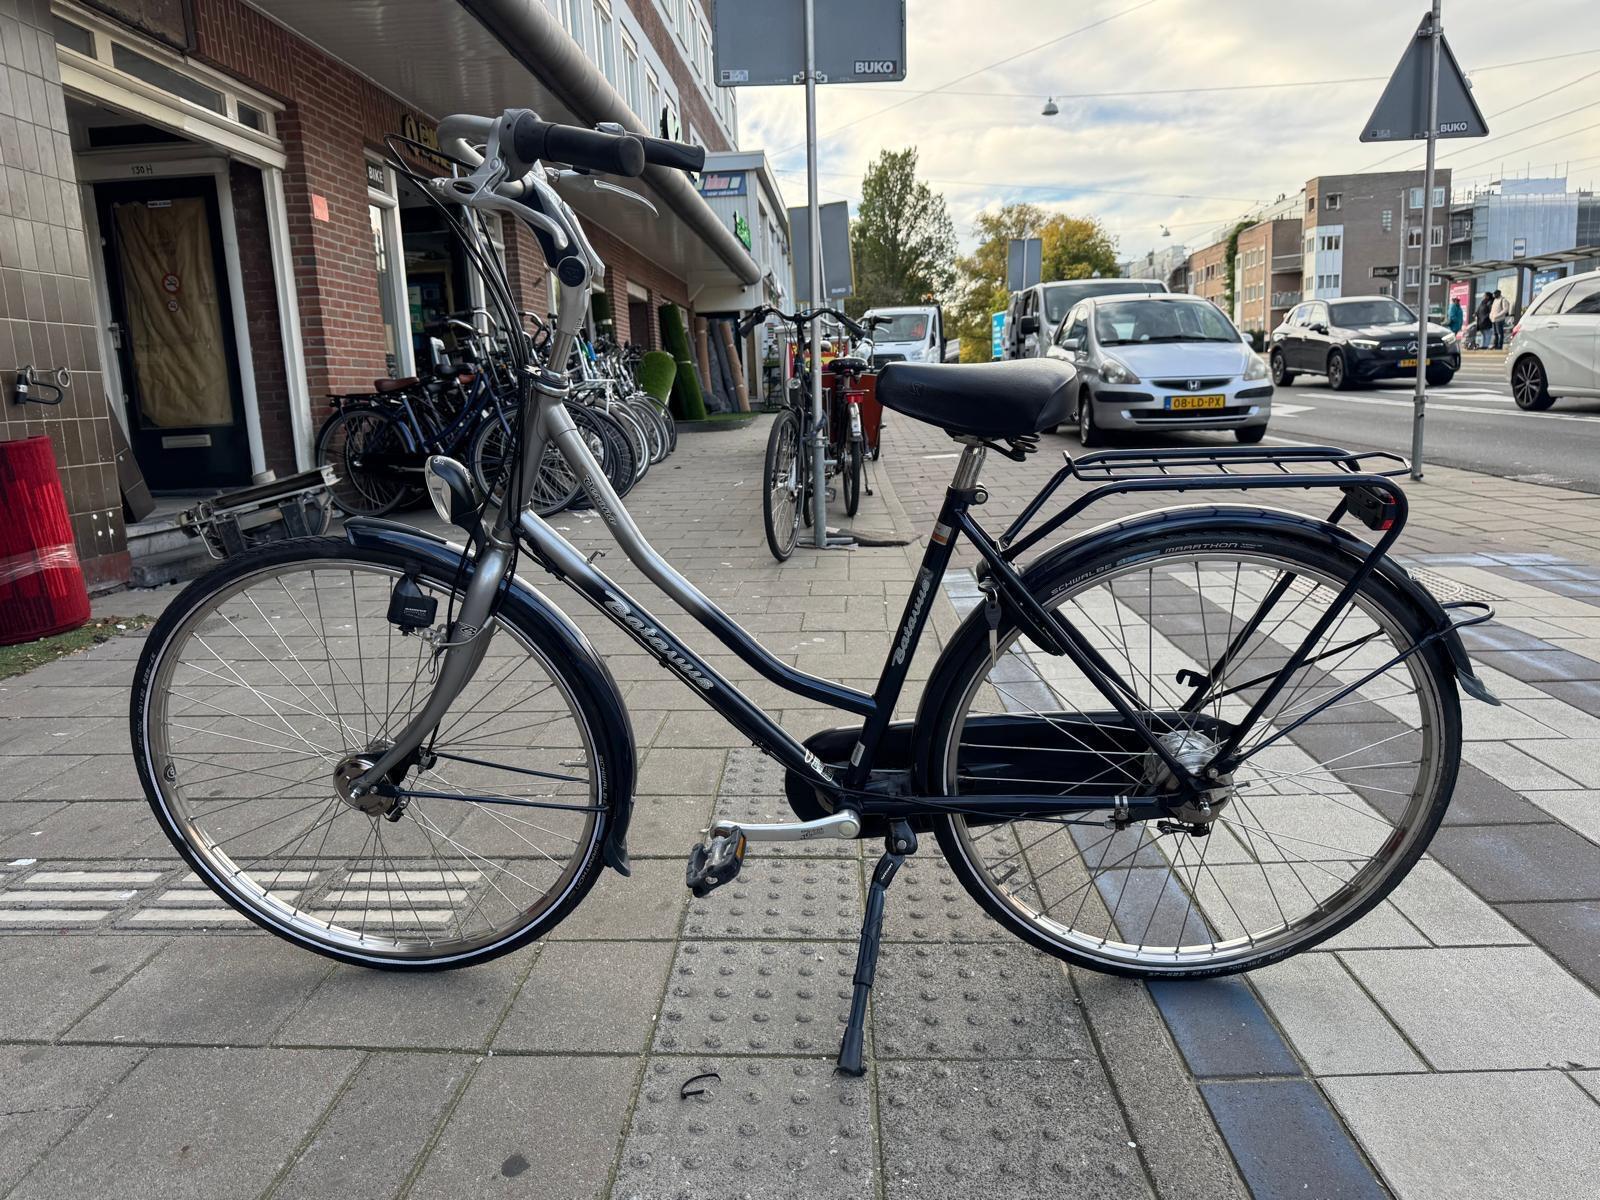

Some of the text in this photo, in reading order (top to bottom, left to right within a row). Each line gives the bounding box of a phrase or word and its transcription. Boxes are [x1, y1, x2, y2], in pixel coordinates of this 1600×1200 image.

[855, 61, 893, 73] BUKO
[1440, 122, 1467, 133] BUKO
[368, 165, 384, 183] BIKE
[1173, 397, 1221, 408] 08-LD-PX
[1165, 541, 1238, 554] MARATHON
[1050, 563, 1112, 595] SCHWALBE
[891, 579, 931, 667] Batavus
[604, 589, 714, 690] Batavus
